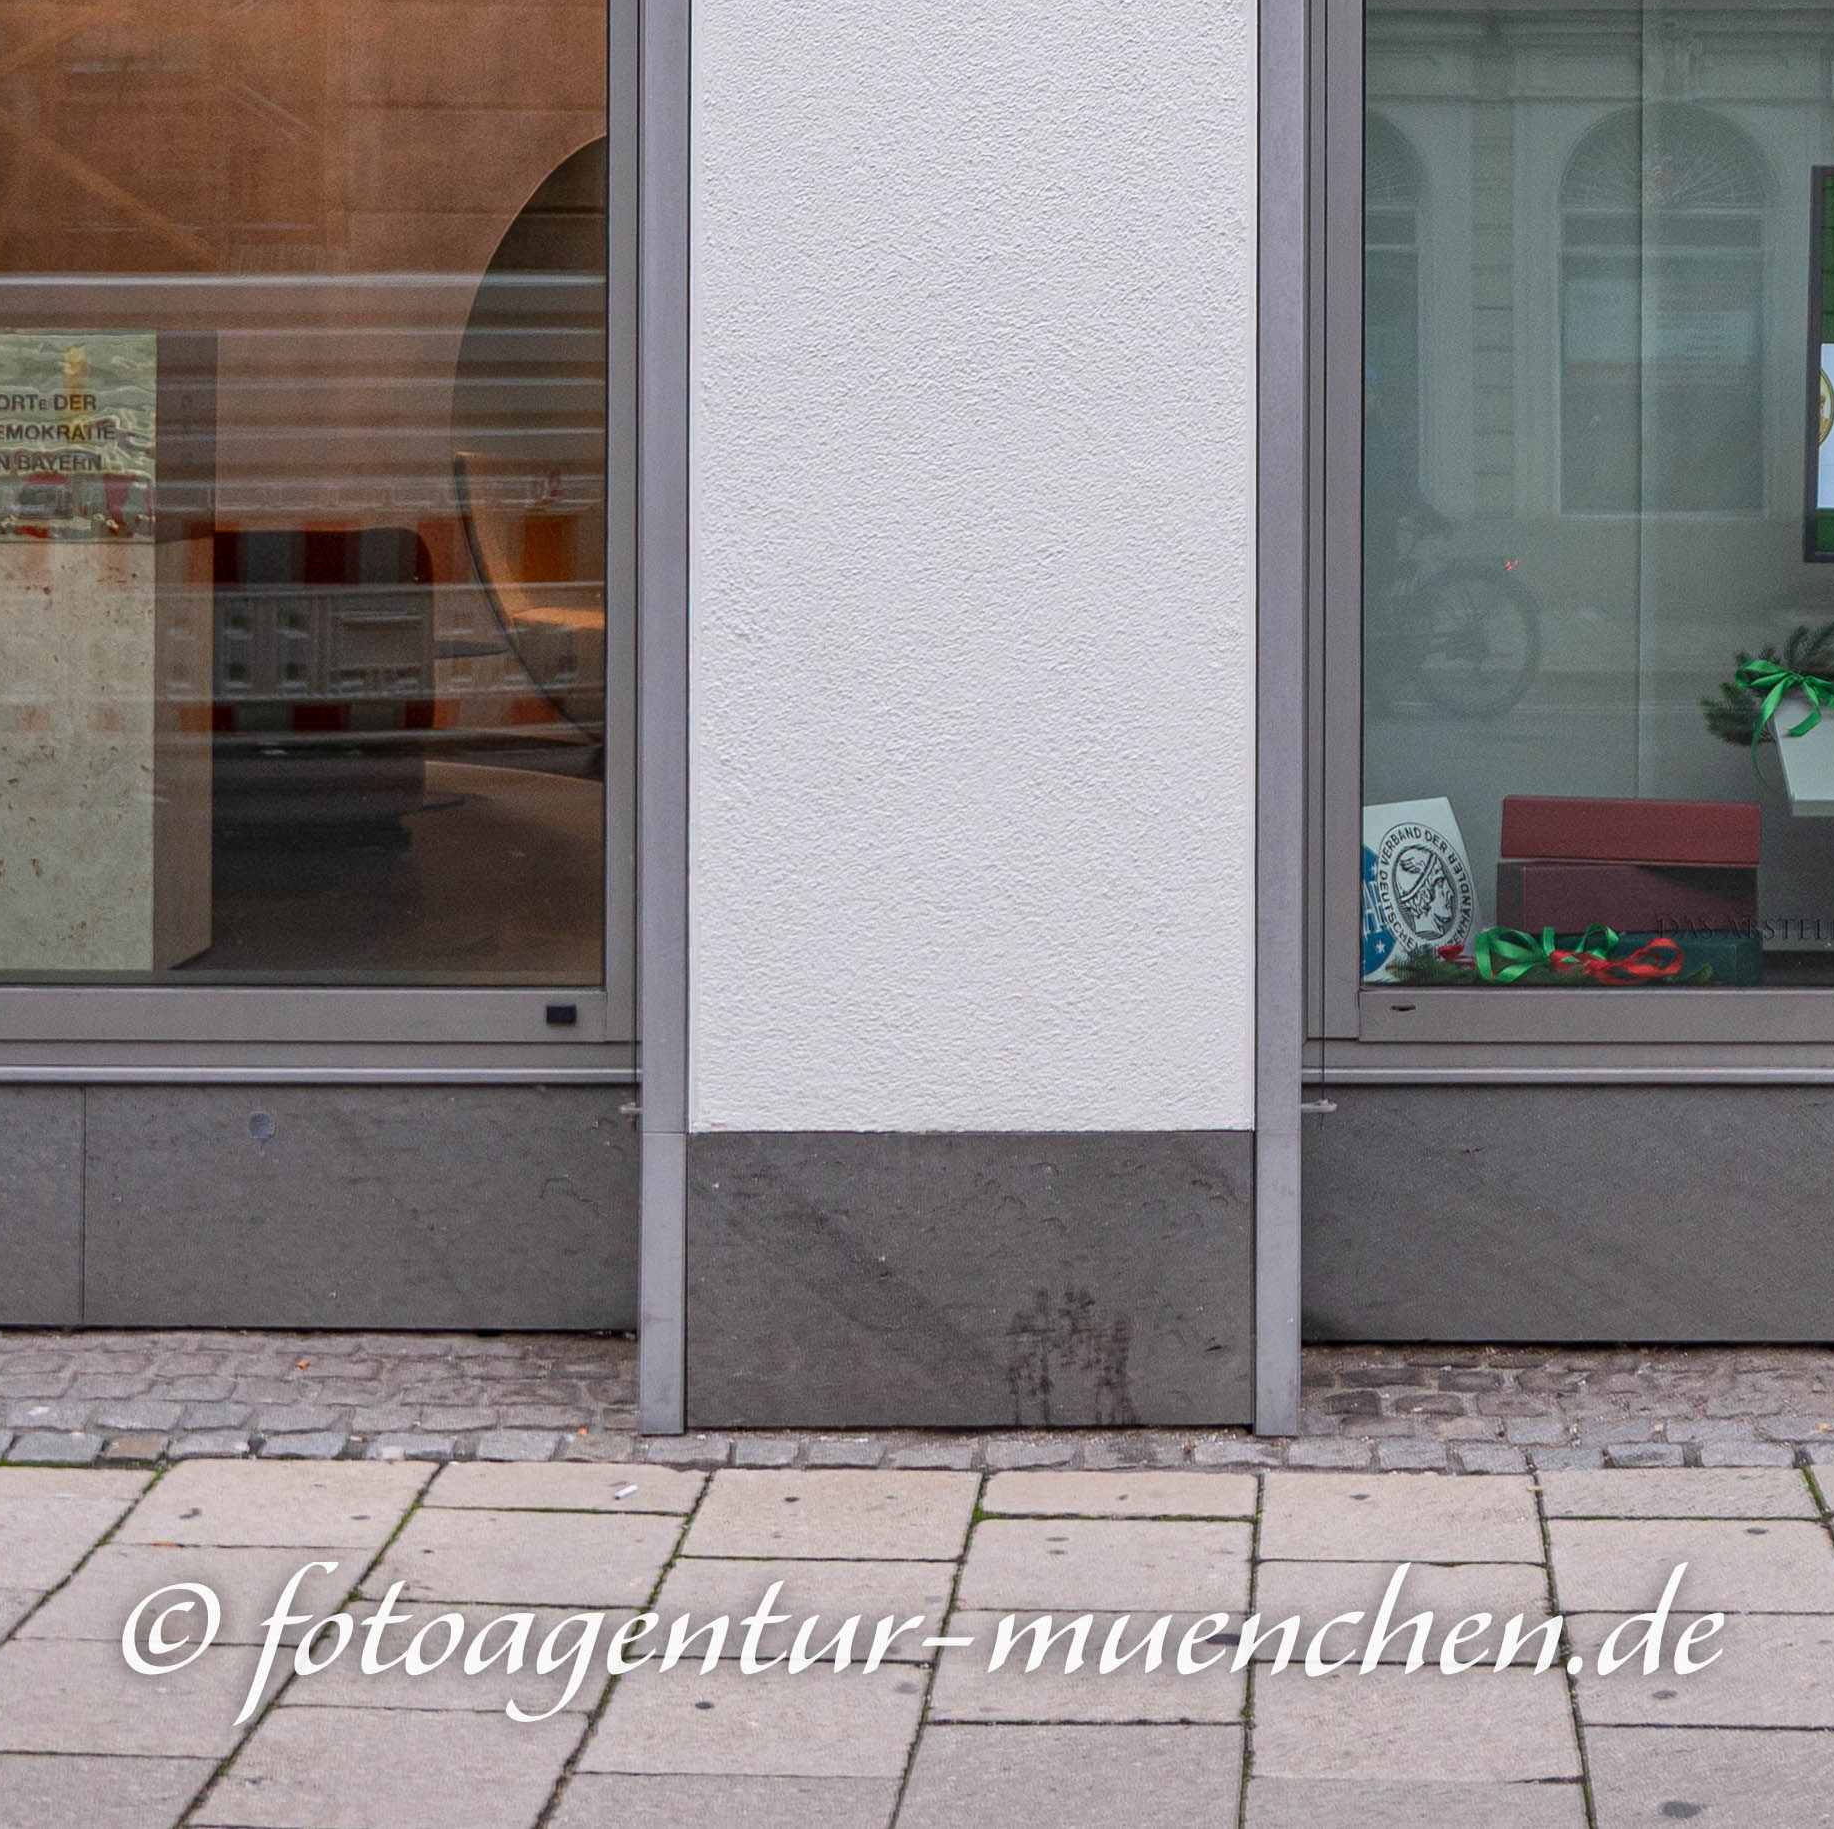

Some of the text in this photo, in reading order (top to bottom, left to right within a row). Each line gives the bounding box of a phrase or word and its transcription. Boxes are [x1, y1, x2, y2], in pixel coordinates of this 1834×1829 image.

[53, 393, 97, 411] DER
[17, 454, 102, 472] BAYERN
[1380, 826, 1423, 869] VERBAND
[1424, 830, 1449, 854] DER
[1379, 869, 1417, 951] DEUTSCHE
